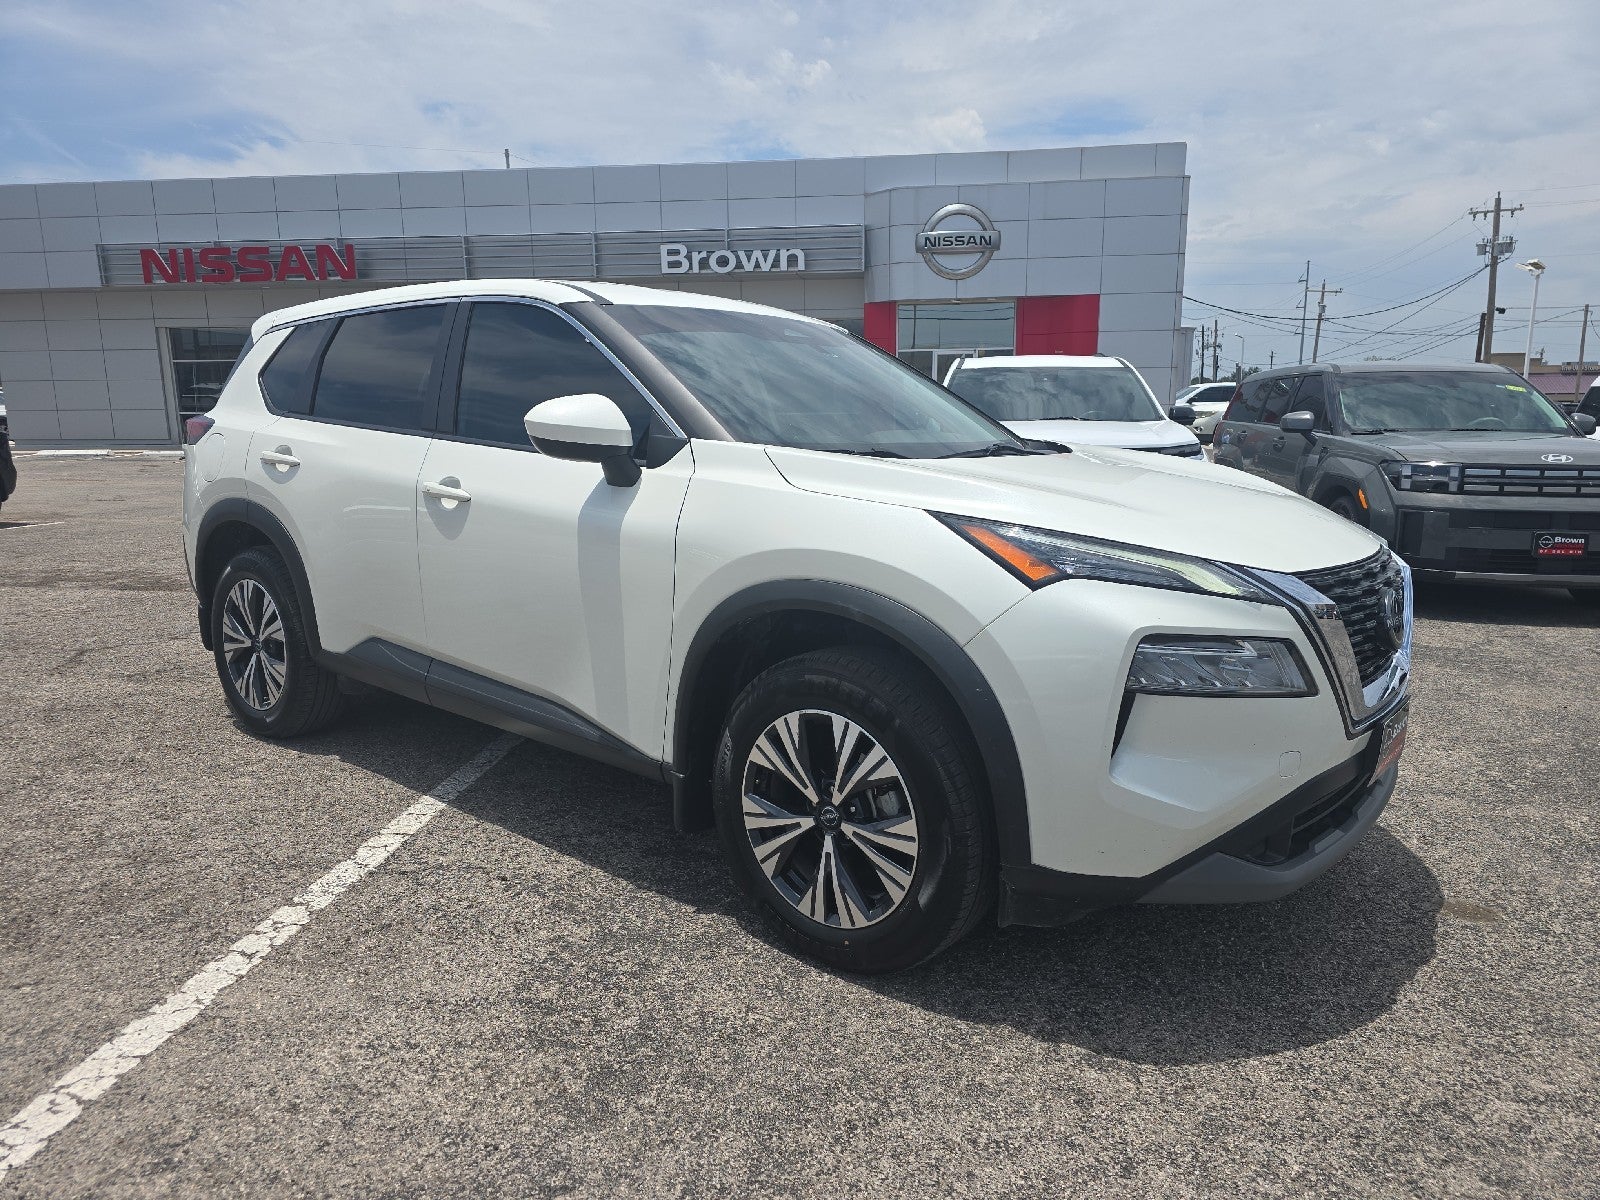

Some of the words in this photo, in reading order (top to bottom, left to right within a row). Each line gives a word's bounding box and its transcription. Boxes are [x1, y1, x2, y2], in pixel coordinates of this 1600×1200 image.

[924, 235, 992, 248] NISSAN
[140, 244, 357, 285] NISSAN
[660, 243, 806, 274] Brown
[1554, 536, 1585, 544] Brown
